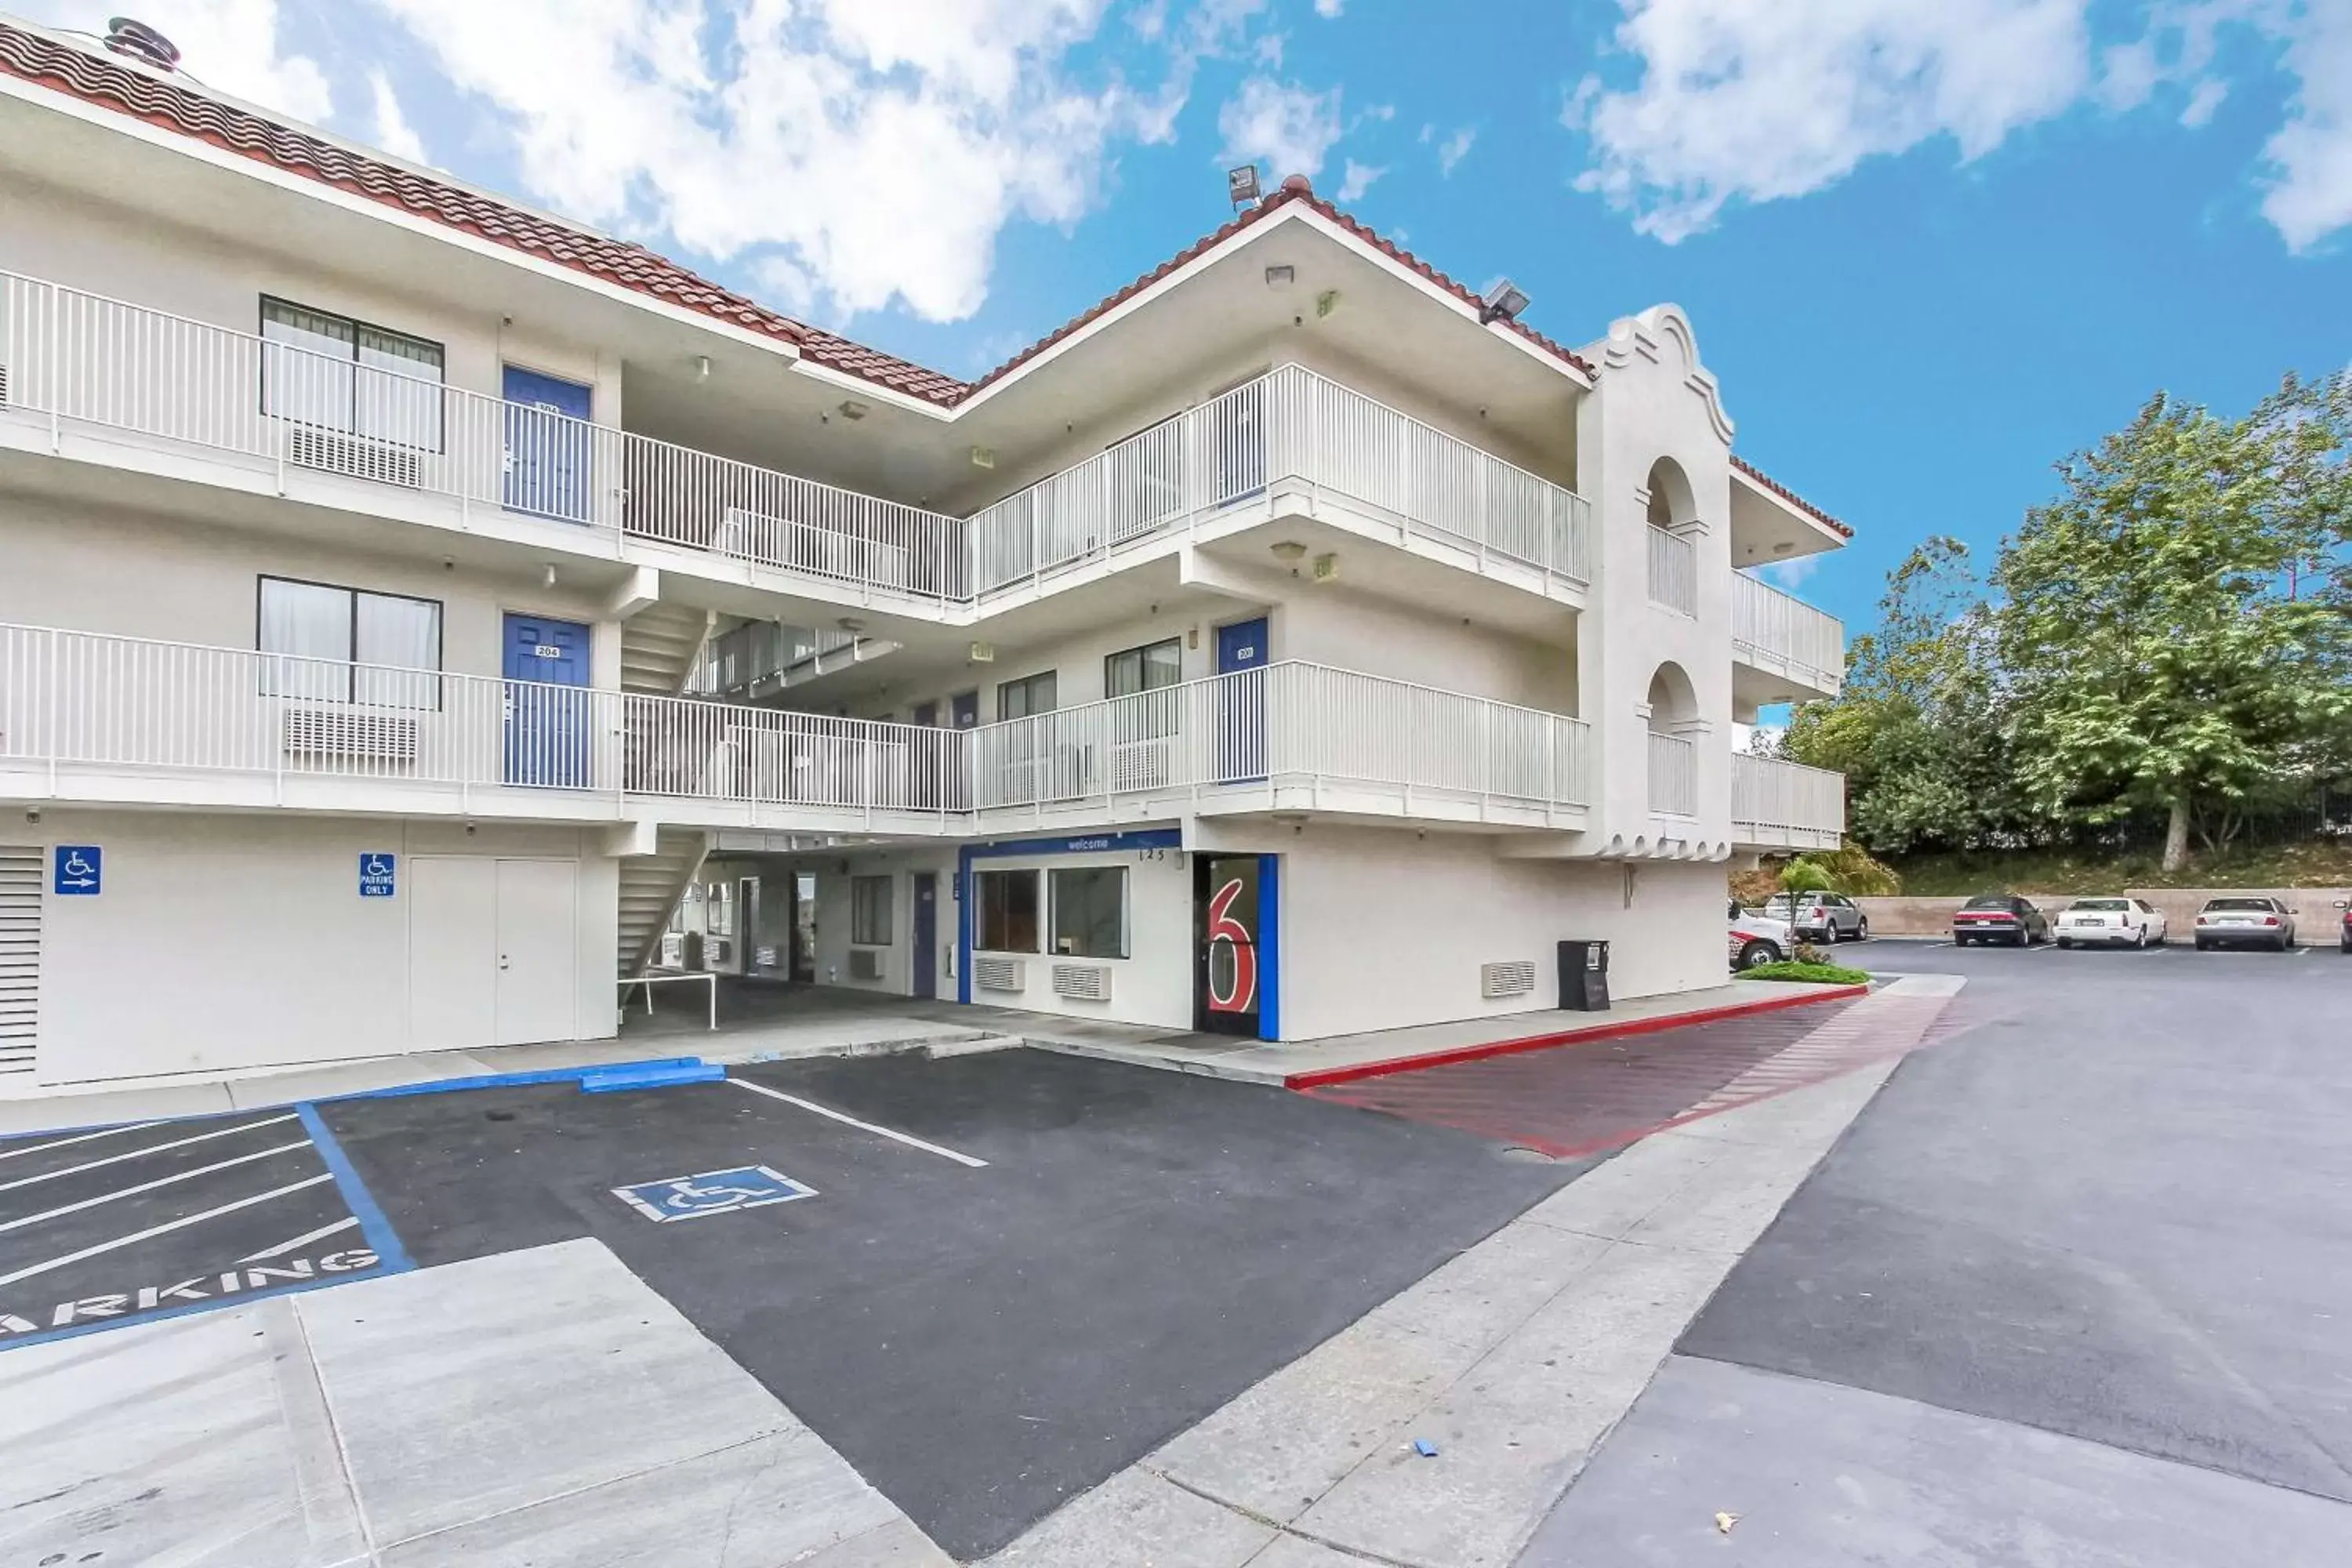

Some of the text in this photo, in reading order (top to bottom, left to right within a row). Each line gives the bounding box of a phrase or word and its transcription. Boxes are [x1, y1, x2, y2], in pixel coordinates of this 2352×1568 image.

[1068, 839, 1109, 850] welcome
[361, 876, 394, 884] PARKING
[366, 885, 387, 894] ONLY
[1209, 878, 1256, 1013] 6
